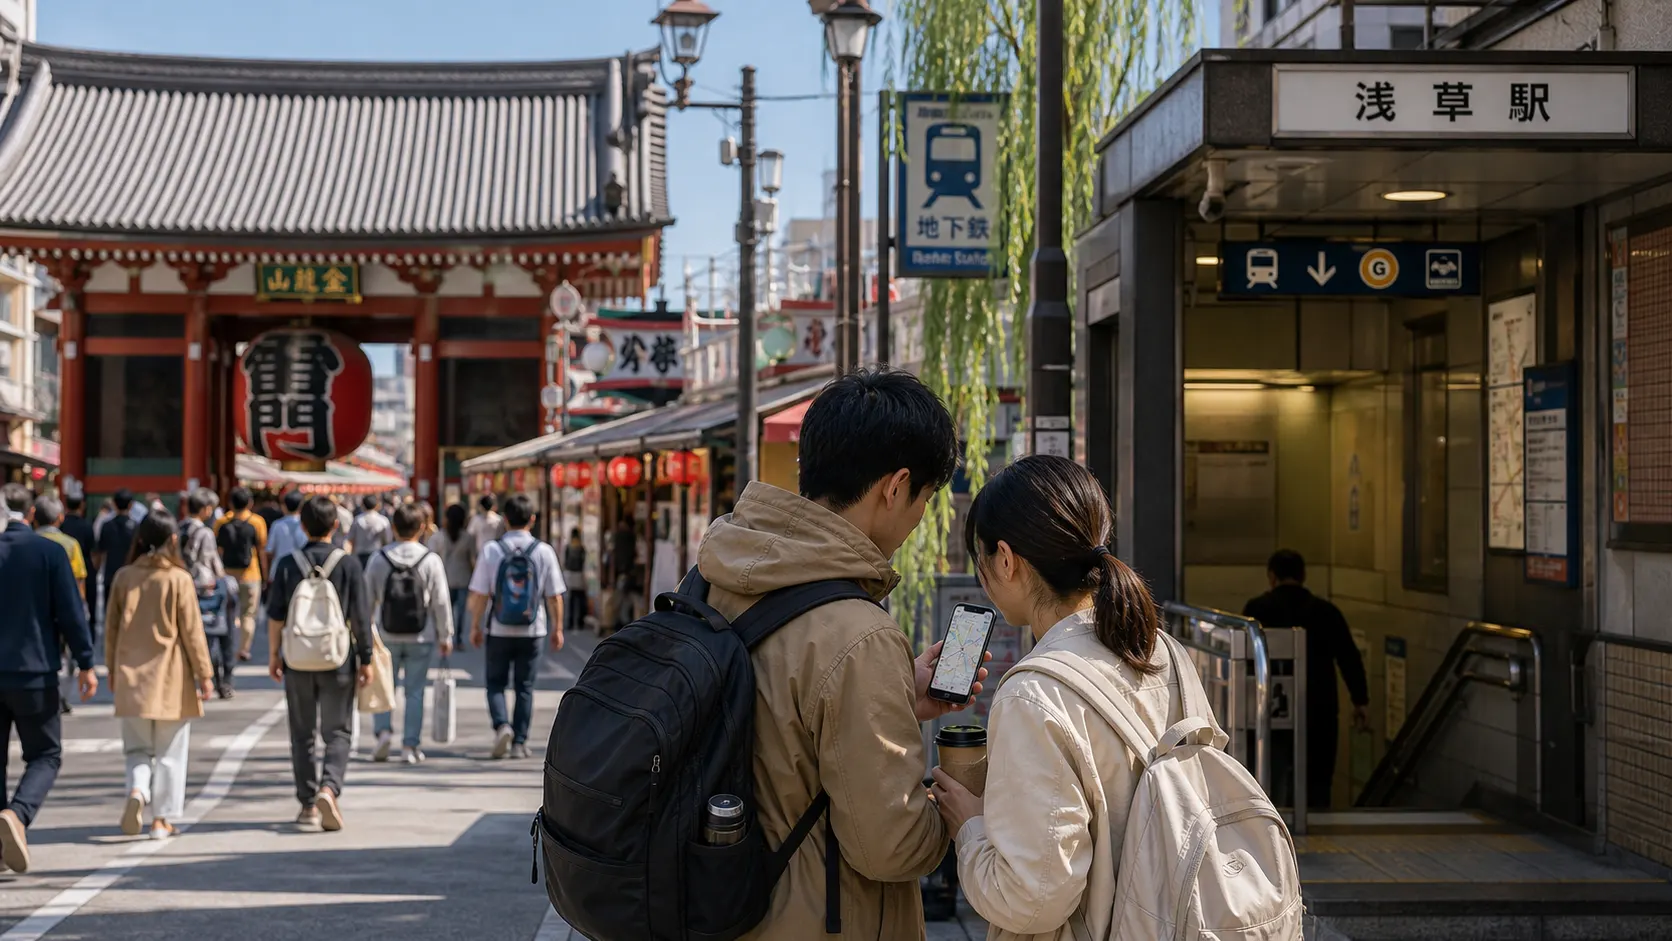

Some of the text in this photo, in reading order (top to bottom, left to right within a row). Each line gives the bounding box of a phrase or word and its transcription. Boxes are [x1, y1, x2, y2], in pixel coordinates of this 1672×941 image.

[1355, 81, 1550, 122] 浅草駅
[917, 216, 989, 240] 地下鉄
[1372, 260, 1386, 277] G
